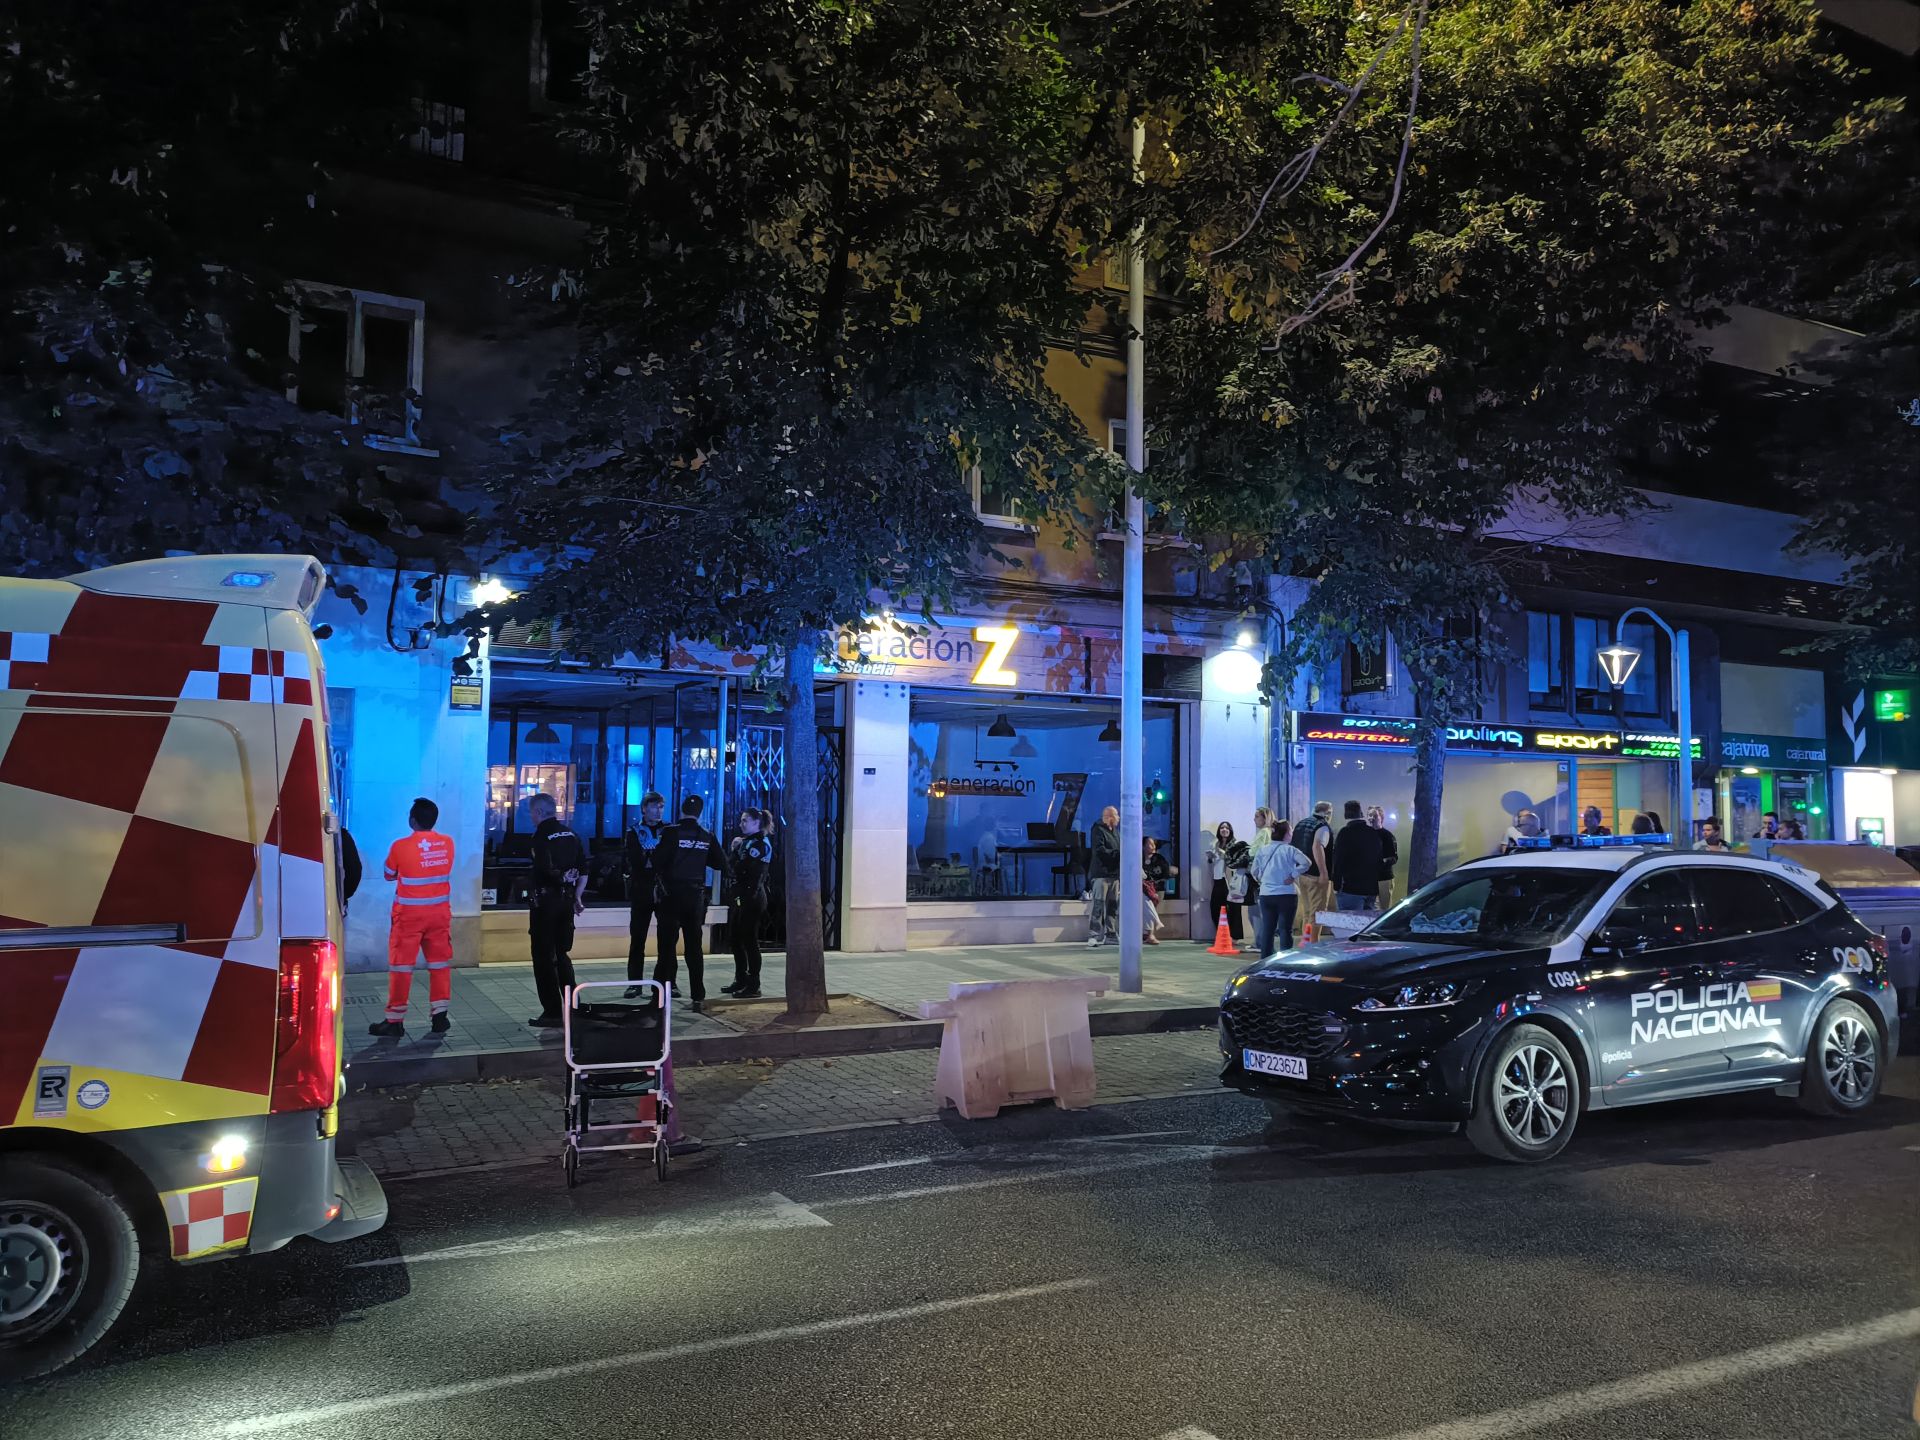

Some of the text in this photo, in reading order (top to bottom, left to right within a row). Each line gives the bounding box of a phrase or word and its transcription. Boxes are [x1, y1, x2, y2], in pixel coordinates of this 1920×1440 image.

[834, 626, 1020, 686] neración Z
[1446, 726, 1619, 750] owling sport
[1630, 1004, 1782, 1046] NACIONAL
